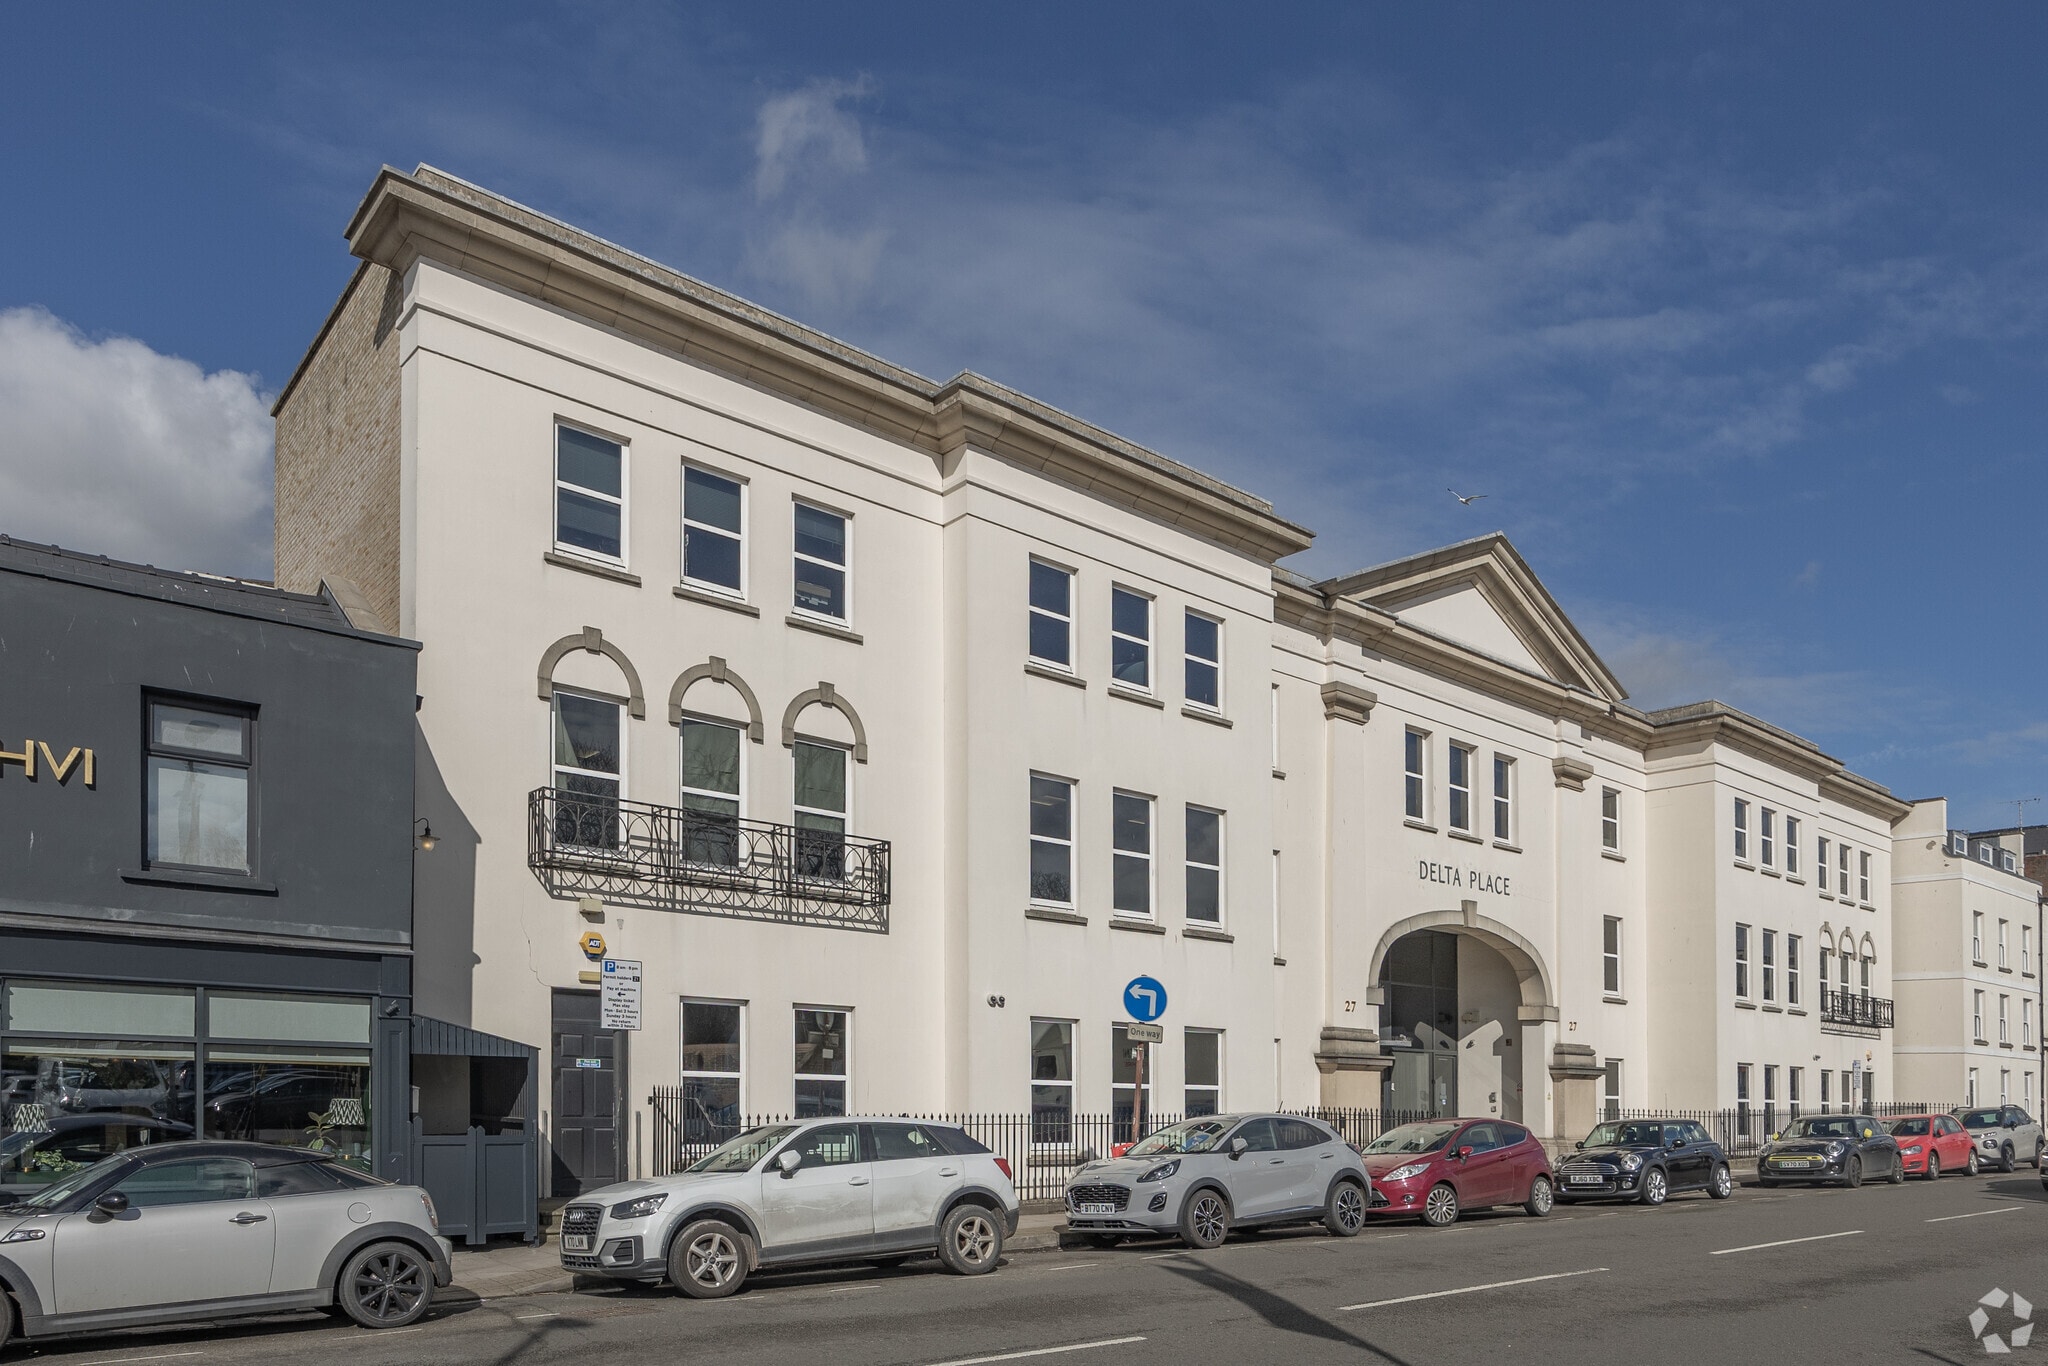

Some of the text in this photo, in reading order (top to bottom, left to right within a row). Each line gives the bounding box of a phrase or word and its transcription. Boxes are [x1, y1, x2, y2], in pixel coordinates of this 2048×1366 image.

[1420, 860, 1510, 896] DELTA PLACE
[589, 940, 600, 948] ADT
[1345, 1000, 1356, 1012] 27
[1569, 1021, 1577, 1031] 27
[1130, 1027, 1160, 1039] One way
[1084, 1204, 1114, 1213] BT70 CNV
